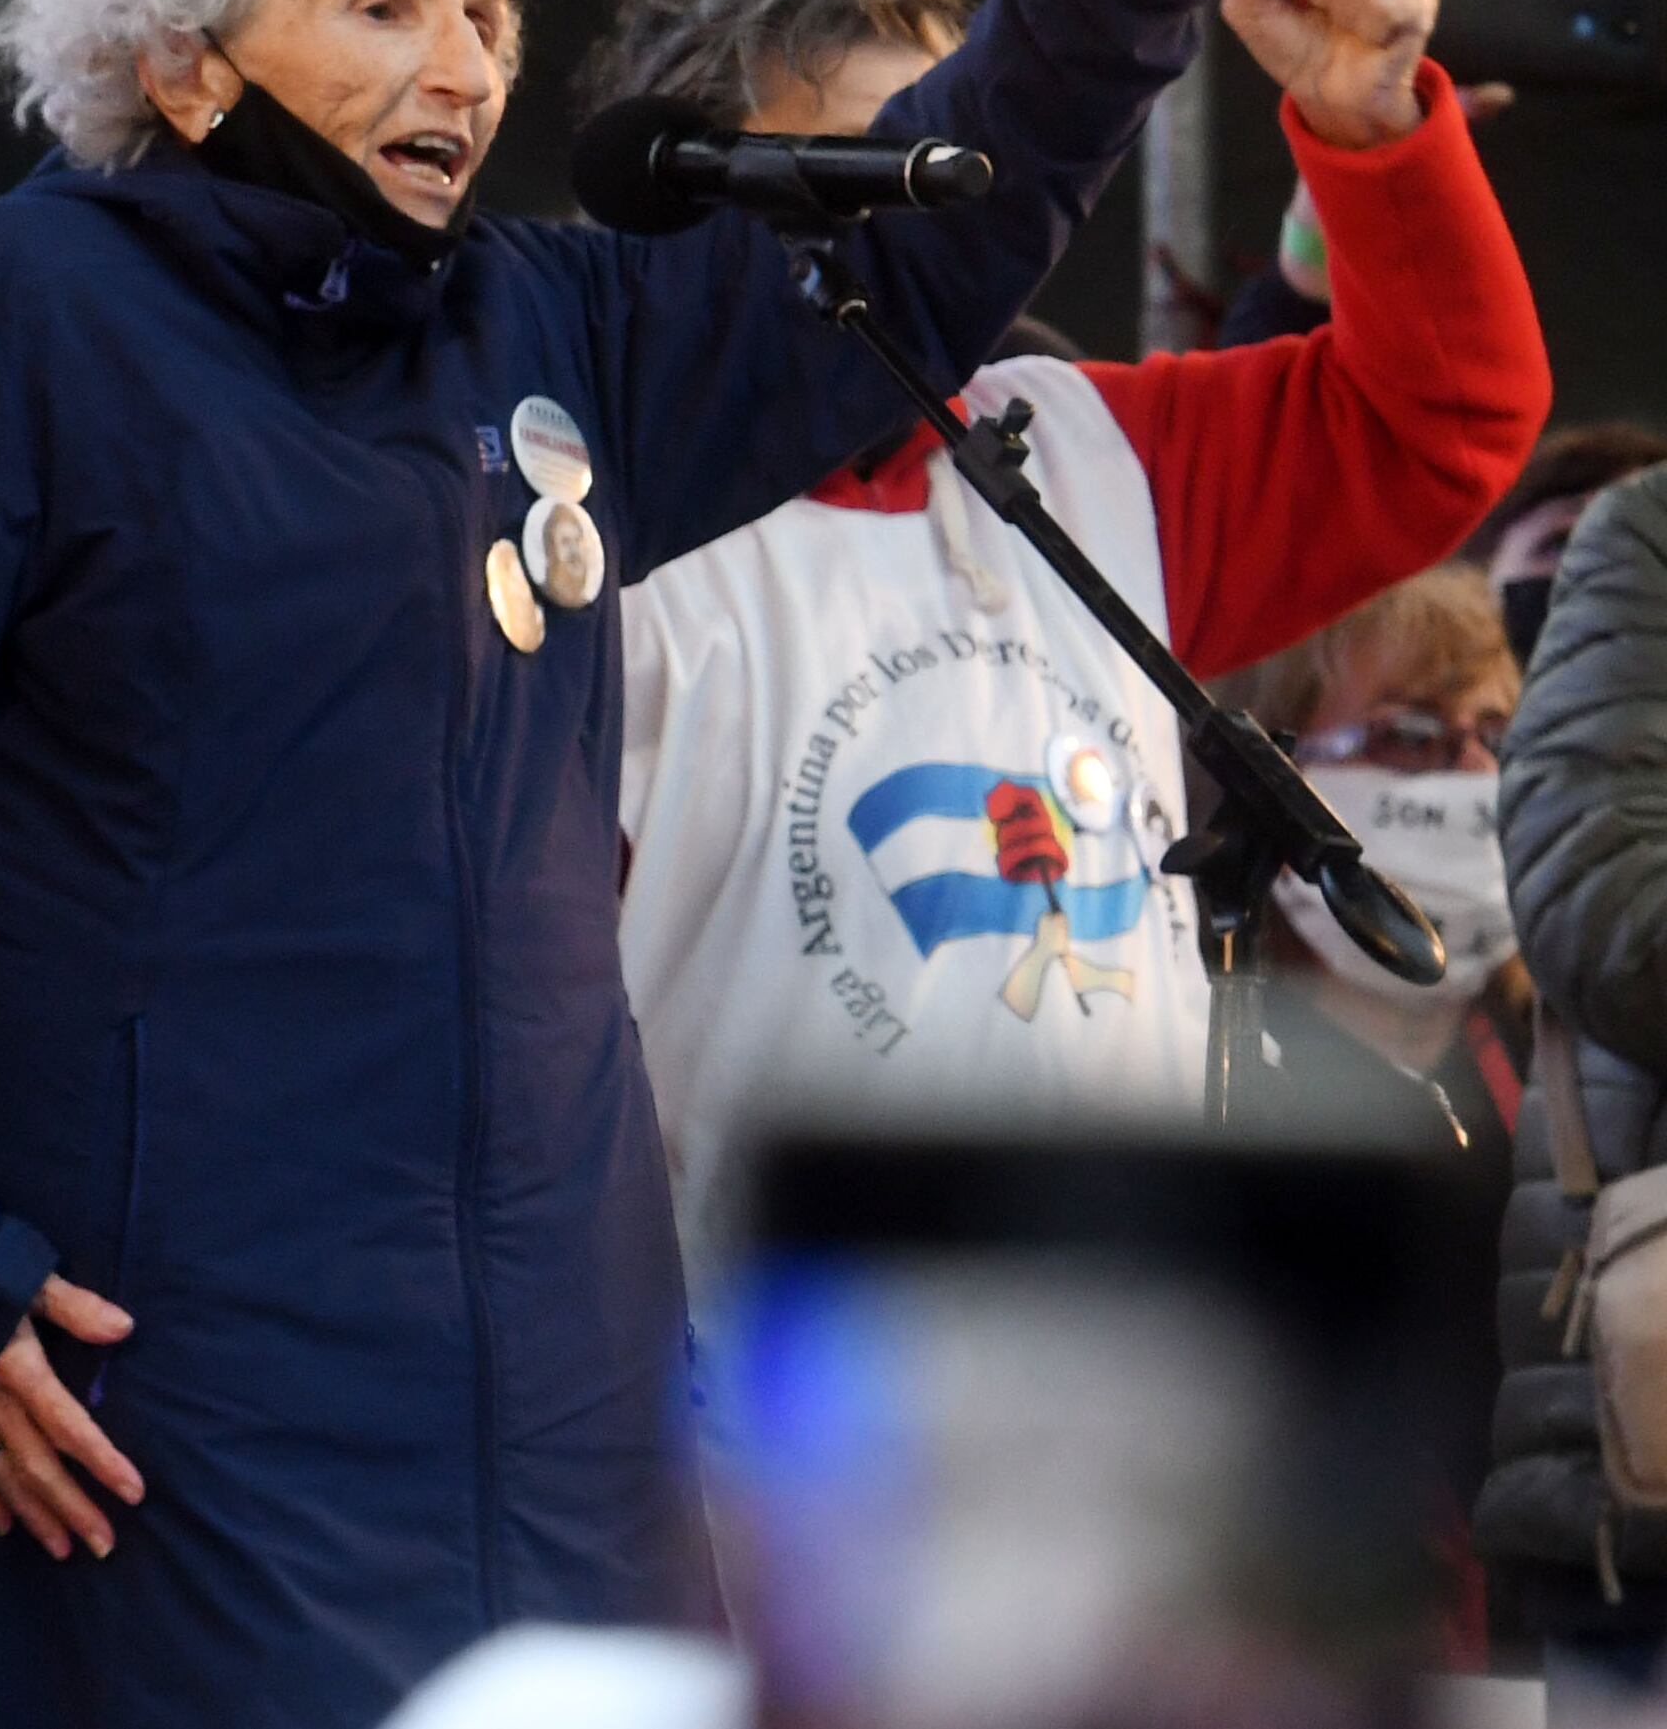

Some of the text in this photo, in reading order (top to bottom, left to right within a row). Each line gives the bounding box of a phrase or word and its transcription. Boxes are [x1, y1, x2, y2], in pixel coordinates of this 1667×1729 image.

[825, 670, 880, 739] por
[868, 645, 939, 685] los
[781, 732, 843, 960] Argentina
[828, 965, 912, 1058] Liga
